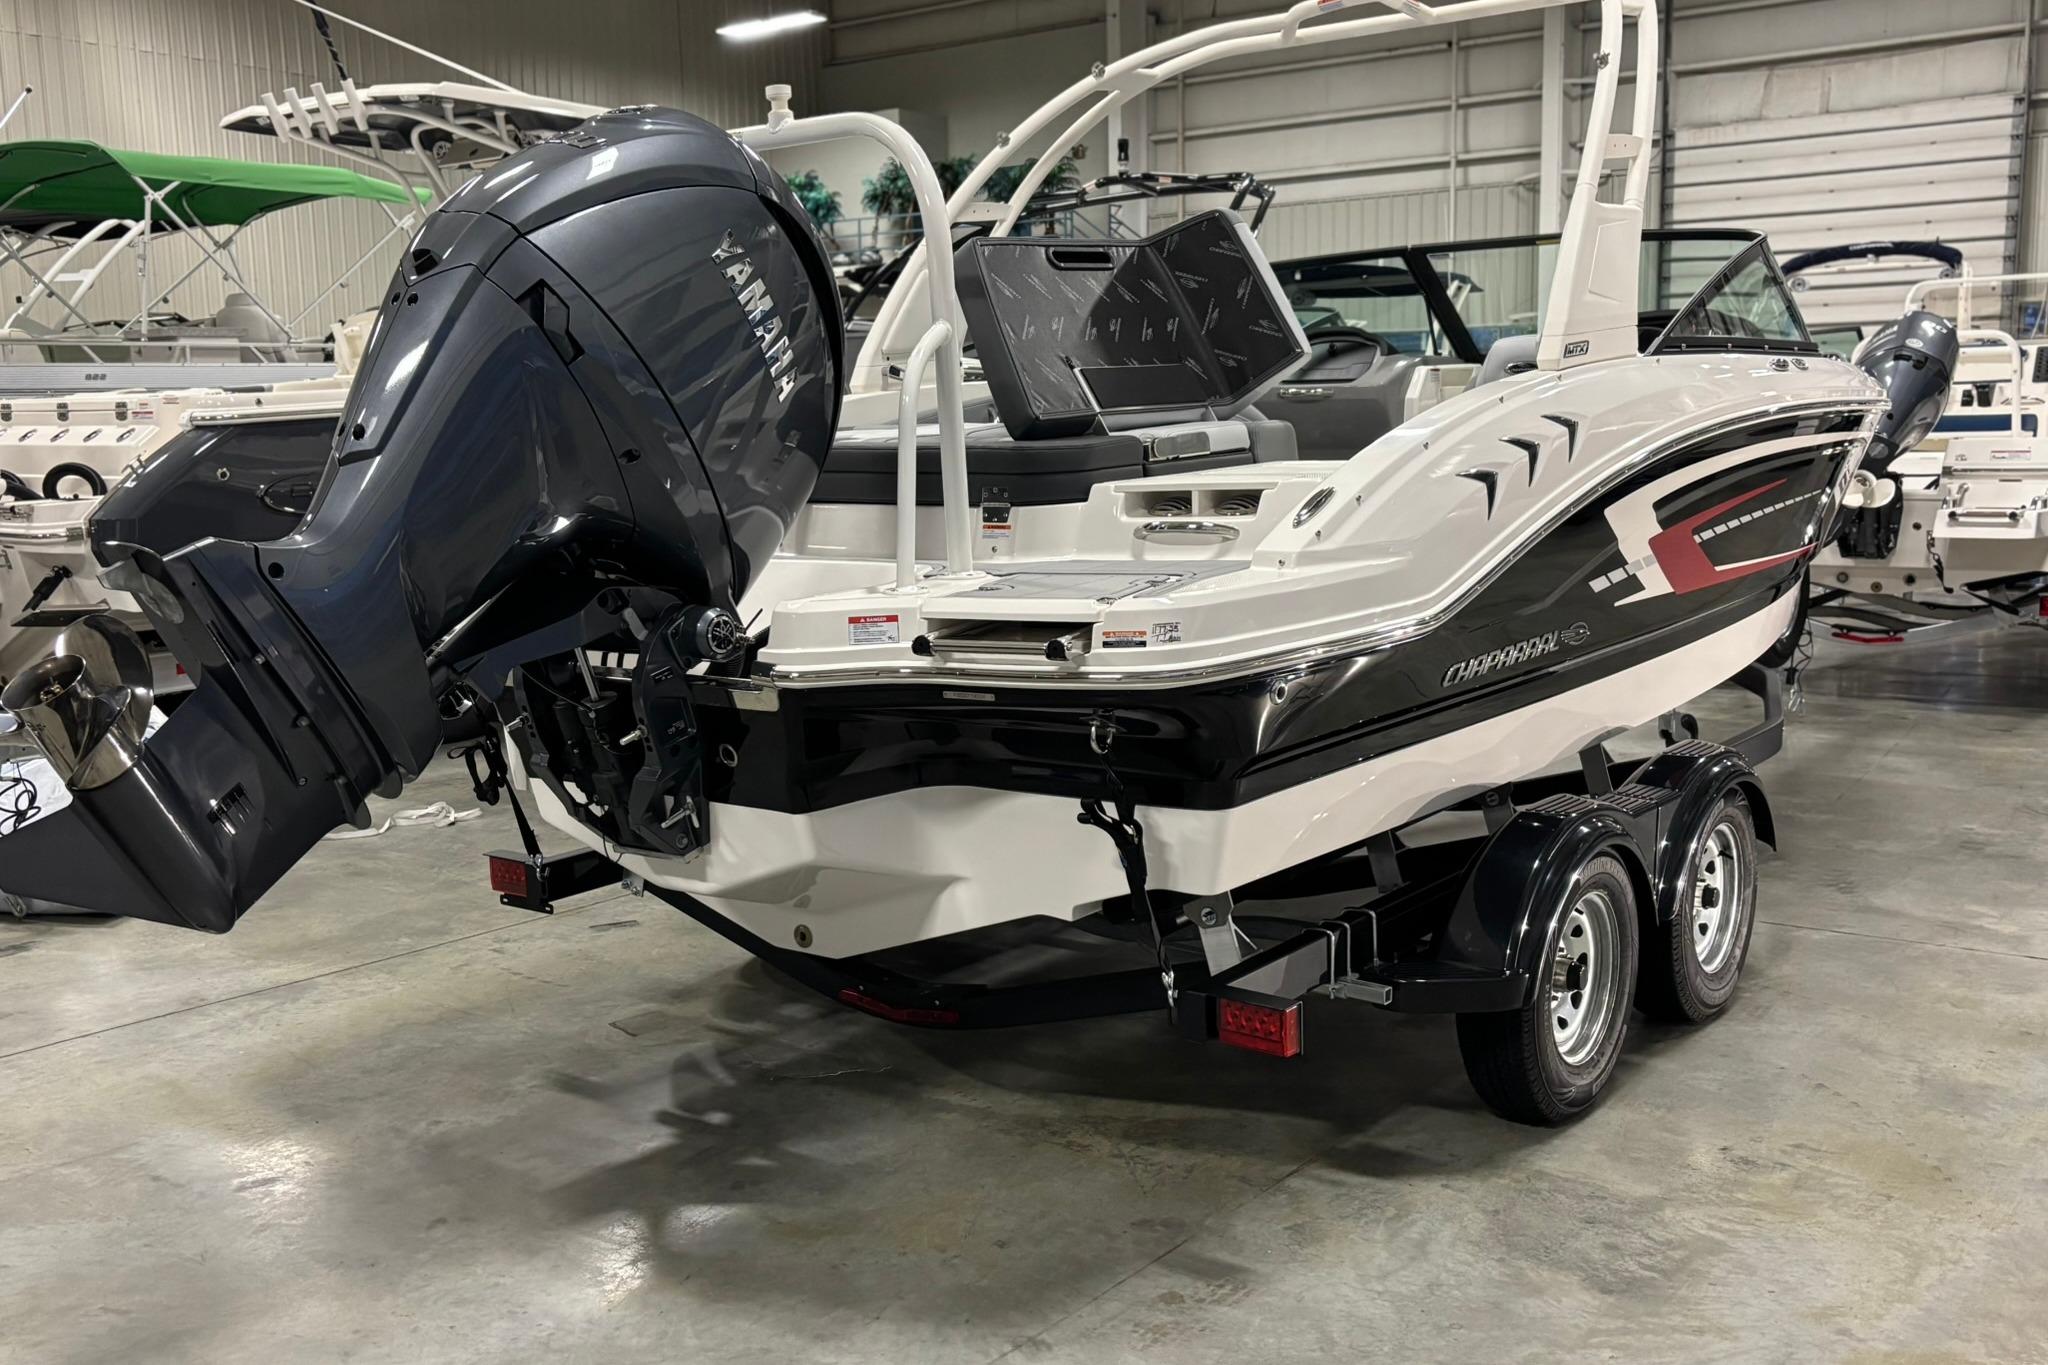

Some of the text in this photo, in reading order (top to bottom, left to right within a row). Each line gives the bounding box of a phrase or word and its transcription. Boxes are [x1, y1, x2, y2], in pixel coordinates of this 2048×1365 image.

[712, 229, 798, 403] YAMAHA
[1567, 343, 1587, 355] MTX
[1442, 630, 1560, 688] CHAPARRAL
